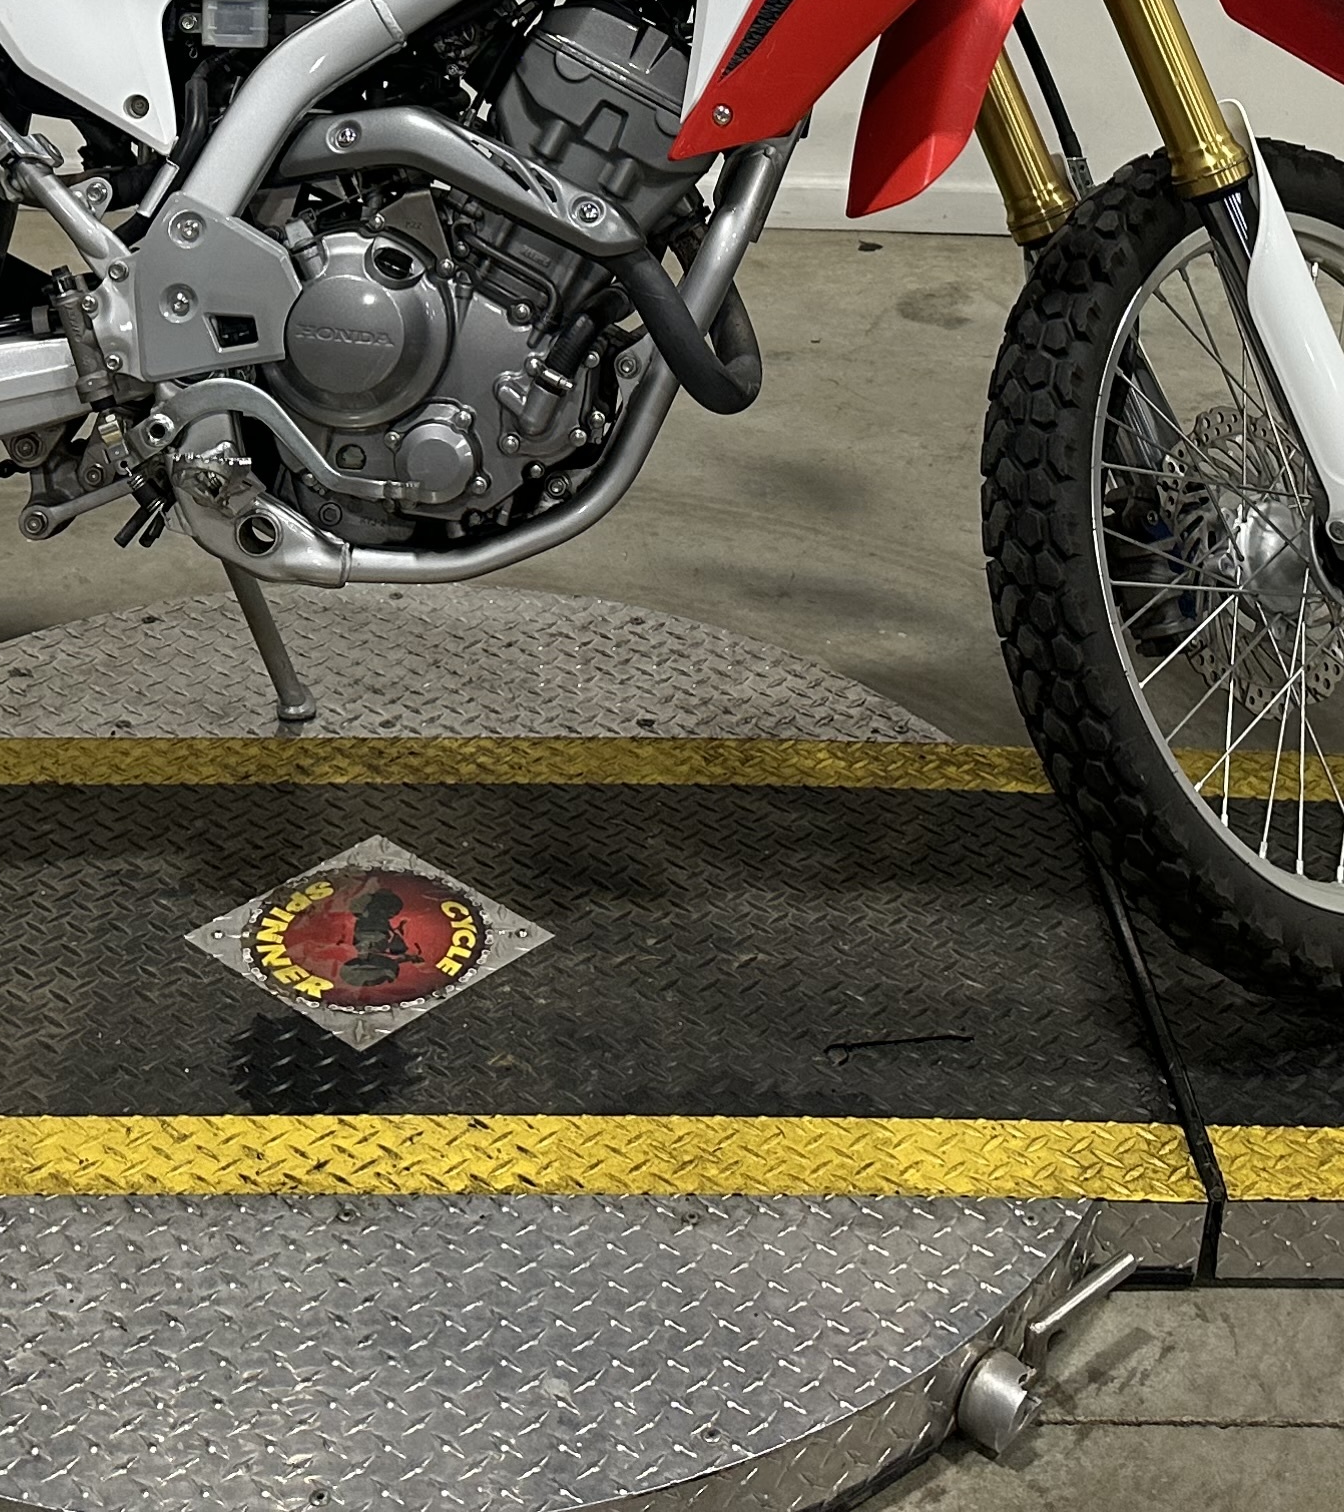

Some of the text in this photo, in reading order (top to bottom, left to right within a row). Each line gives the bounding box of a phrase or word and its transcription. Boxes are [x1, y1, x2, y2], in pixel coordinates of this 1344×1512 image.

[296, 324, 395, 347] HONDA
[256, 881, 334, 998] SPINNER
[436, 901, 478, 977] CYCLE
